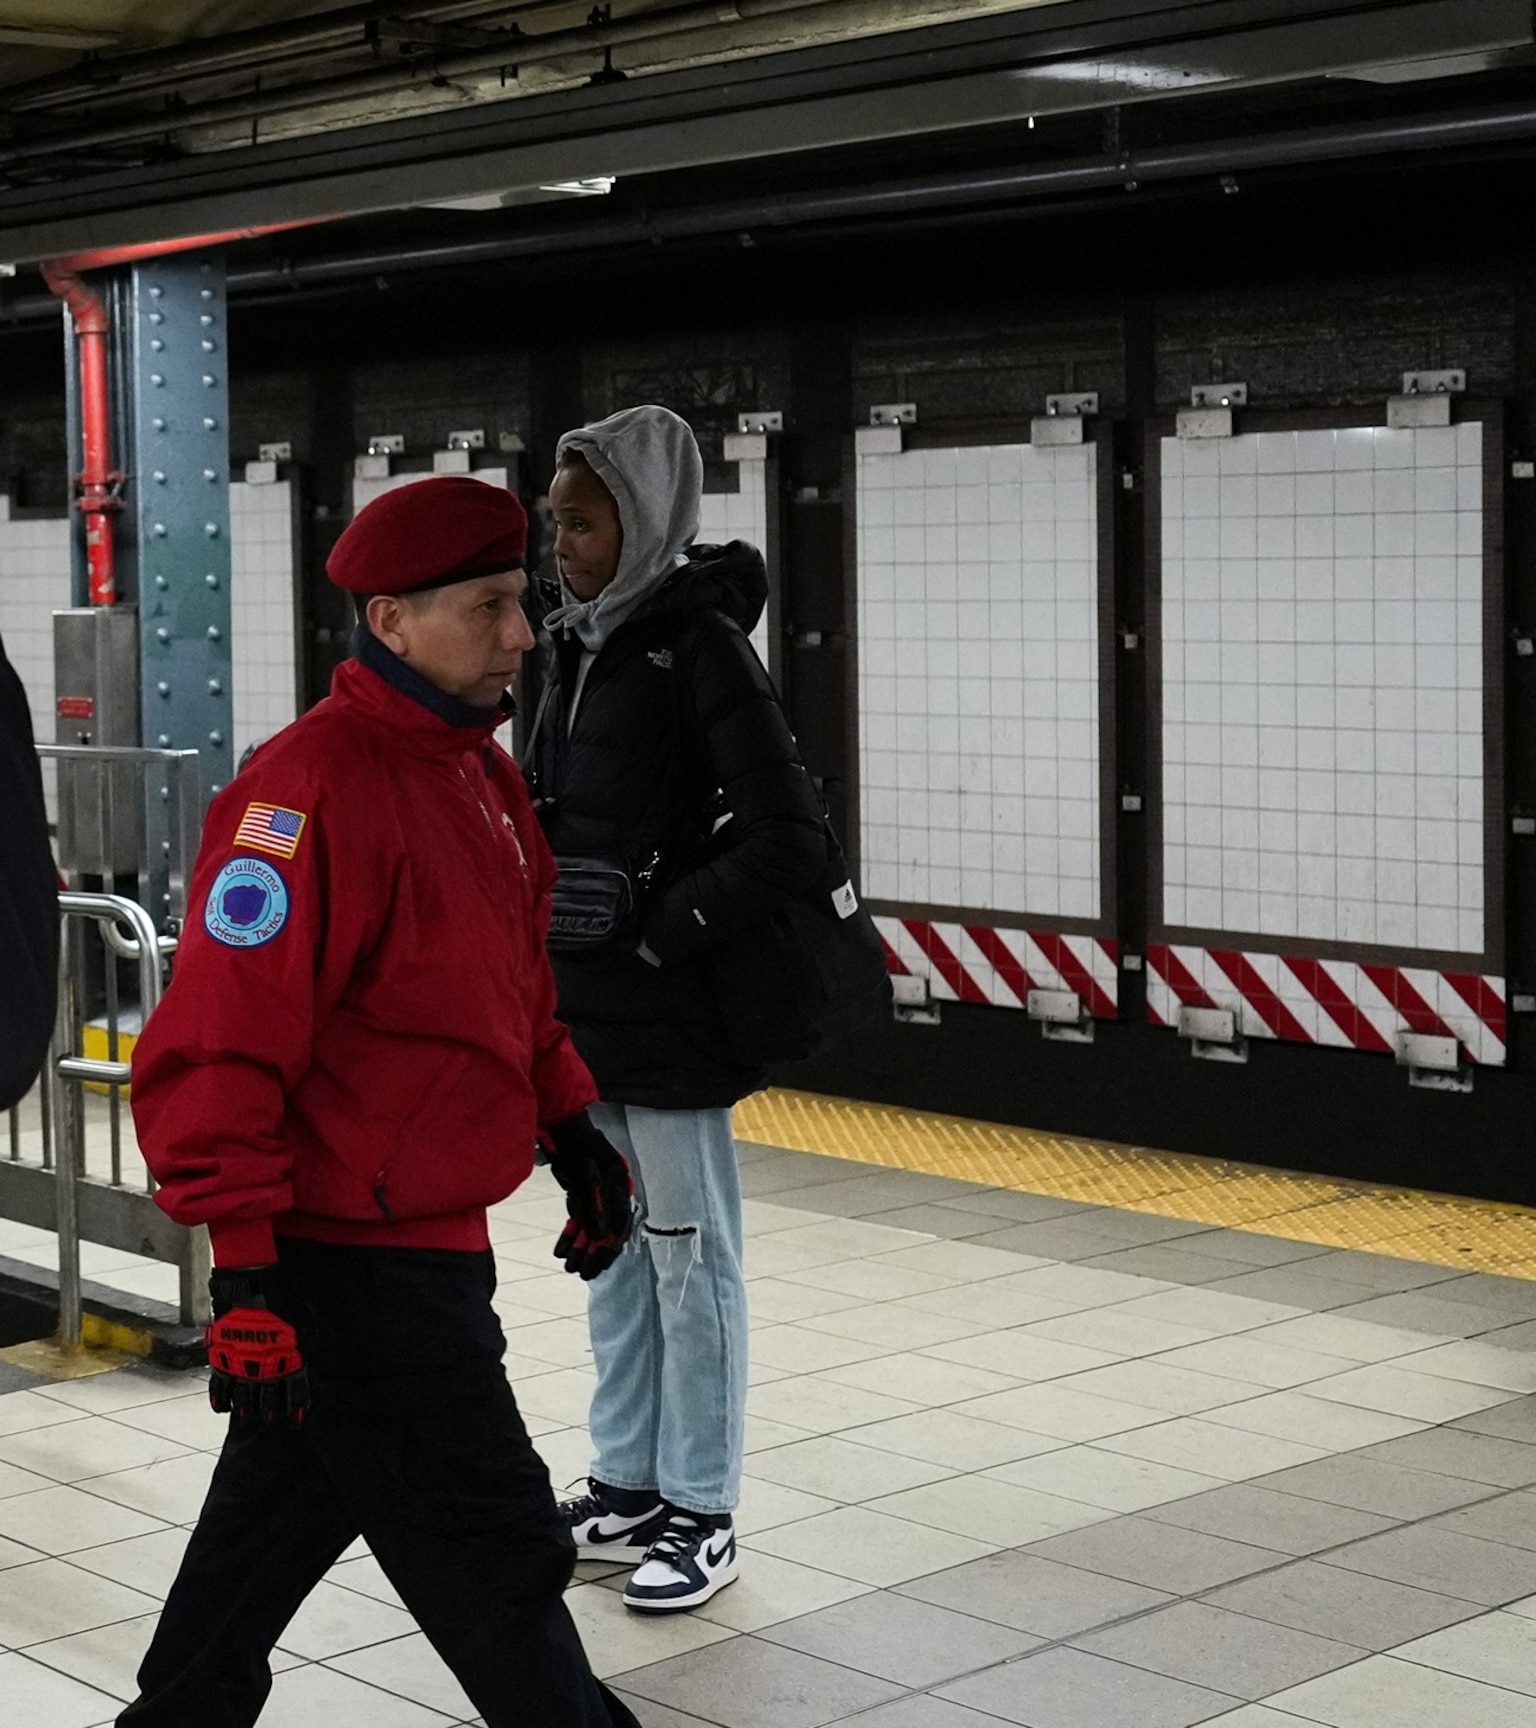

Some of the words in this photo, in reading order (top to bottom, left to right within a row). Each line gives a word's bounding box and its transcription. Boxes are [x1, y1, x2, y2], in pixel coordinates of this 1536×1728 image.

[224, 860, 280, 893] Guillermo
[209, 918, 248, 944] Defense
[252, 912, 283, 941] Tactics
[220, 1327, 278, 1345] HARDY
